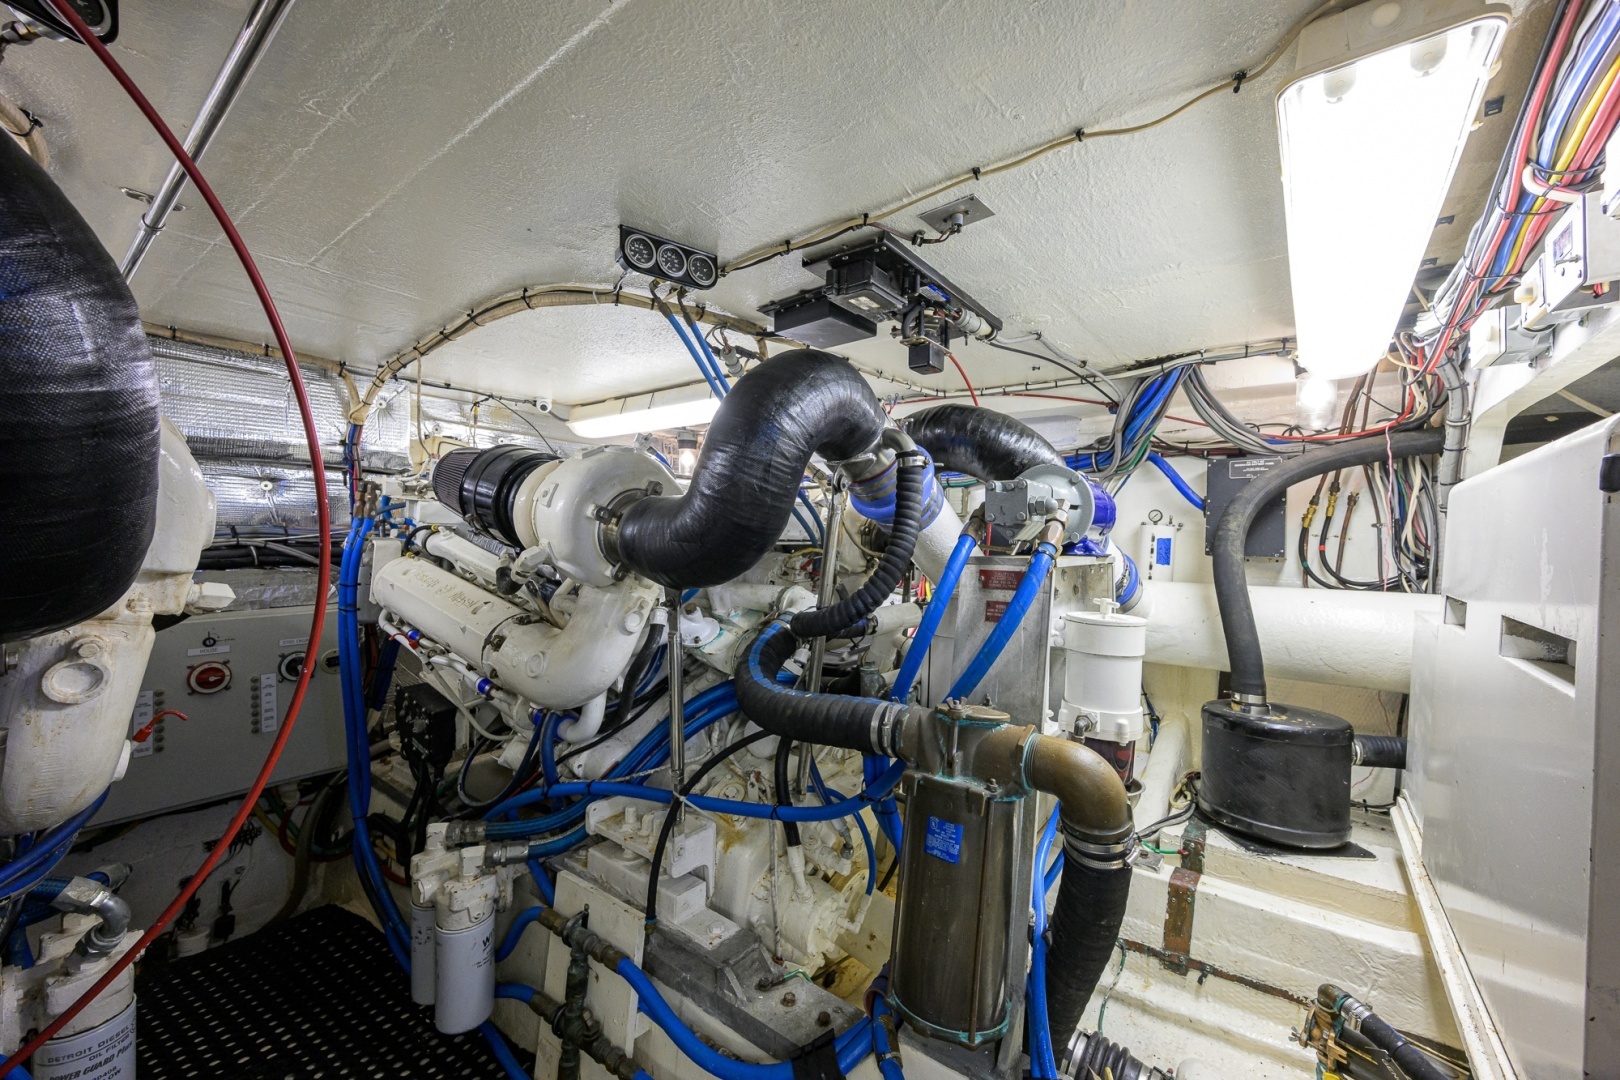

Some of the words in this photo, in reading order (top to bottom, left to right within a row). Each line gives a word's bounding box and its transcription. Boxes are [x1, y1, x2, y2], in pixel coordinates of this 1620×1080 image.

[47, 1046, 93, 1063] DETROIT
[97, 1025, 129, 1048] DIESEL
[83, 1053, 115, 1075] GUARD
[116, 1040, 133, 1058] Plus
[88, 1051, 103, 1061] OIL
[105, 1032, 130, 1053] FILTER
